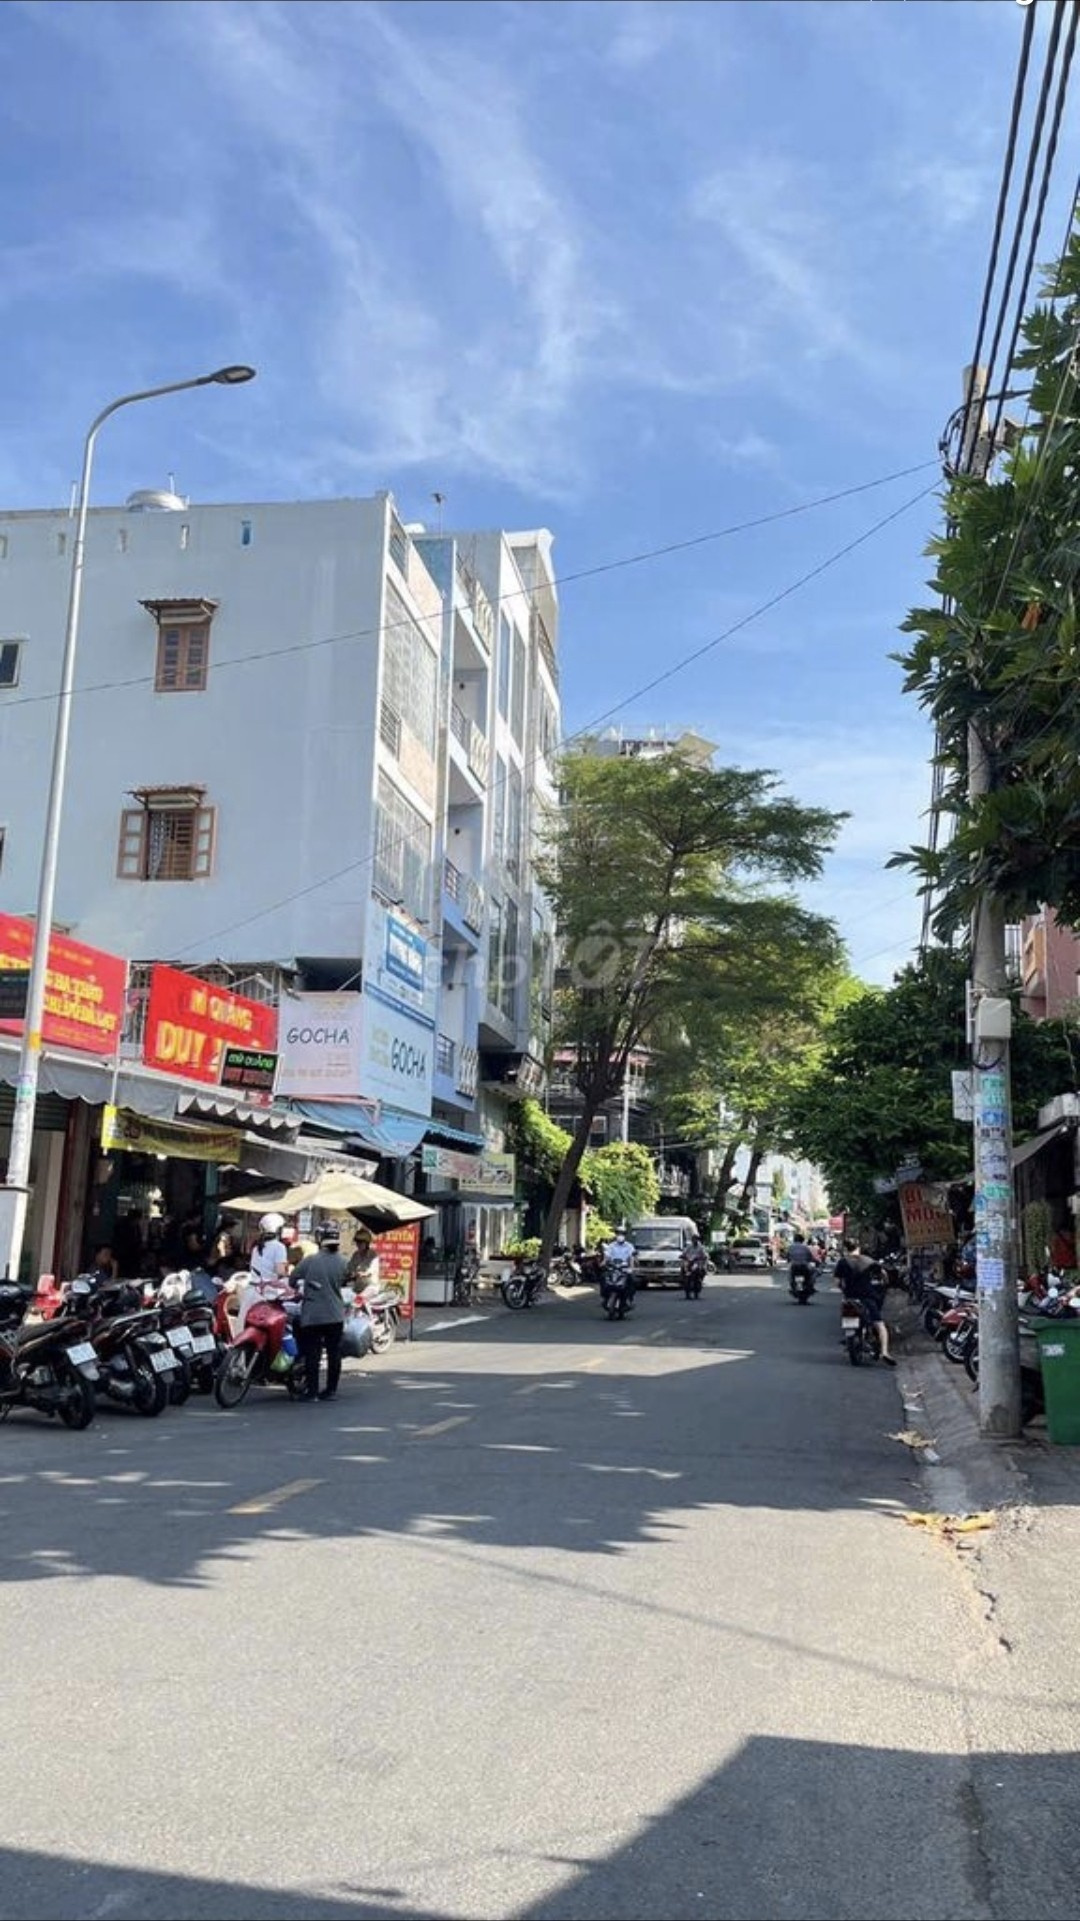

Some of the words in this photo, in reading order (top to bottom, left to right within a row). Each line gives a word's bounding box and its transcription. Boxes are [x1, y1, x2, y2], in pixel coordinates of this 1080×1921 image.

[155, 1020, 207, 1068] DUY
[286, 1026, 350, 1045] GOCHA
[391, 1036, 427, 1080] GOCHA
